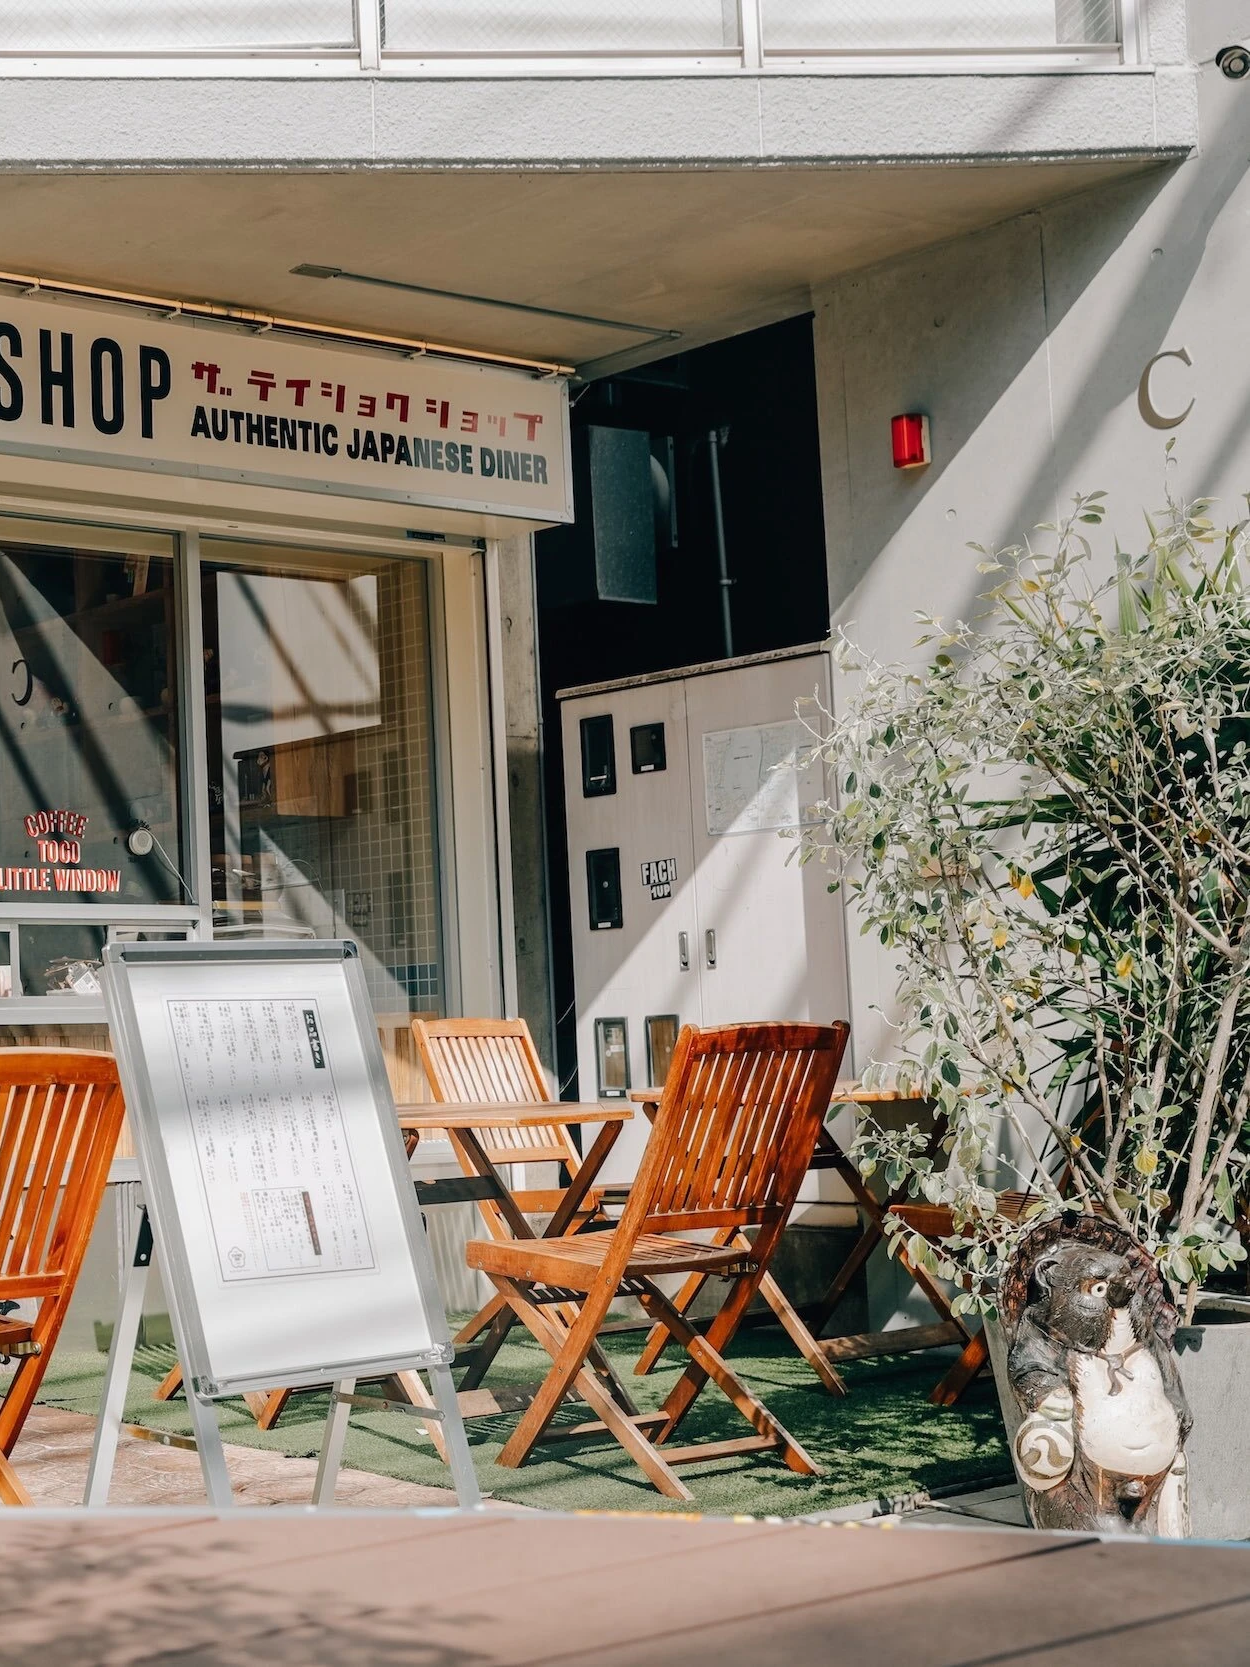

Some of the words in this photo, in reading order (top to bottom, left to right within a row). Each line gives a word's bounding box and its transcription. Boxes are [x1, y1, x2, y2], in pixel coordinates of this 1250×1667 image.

[1137, 345, 1196, 430] C
[190, 405, 338, 456] AUTHENTIC
[346, 428, 474, 475] JAPANESE
[480, 446, 548, 484] DINER
[23, 810, 89, 839] COFFEE
[53, 868, 121, 892] WINDOW
[641, 859, 677, 885] FACH
